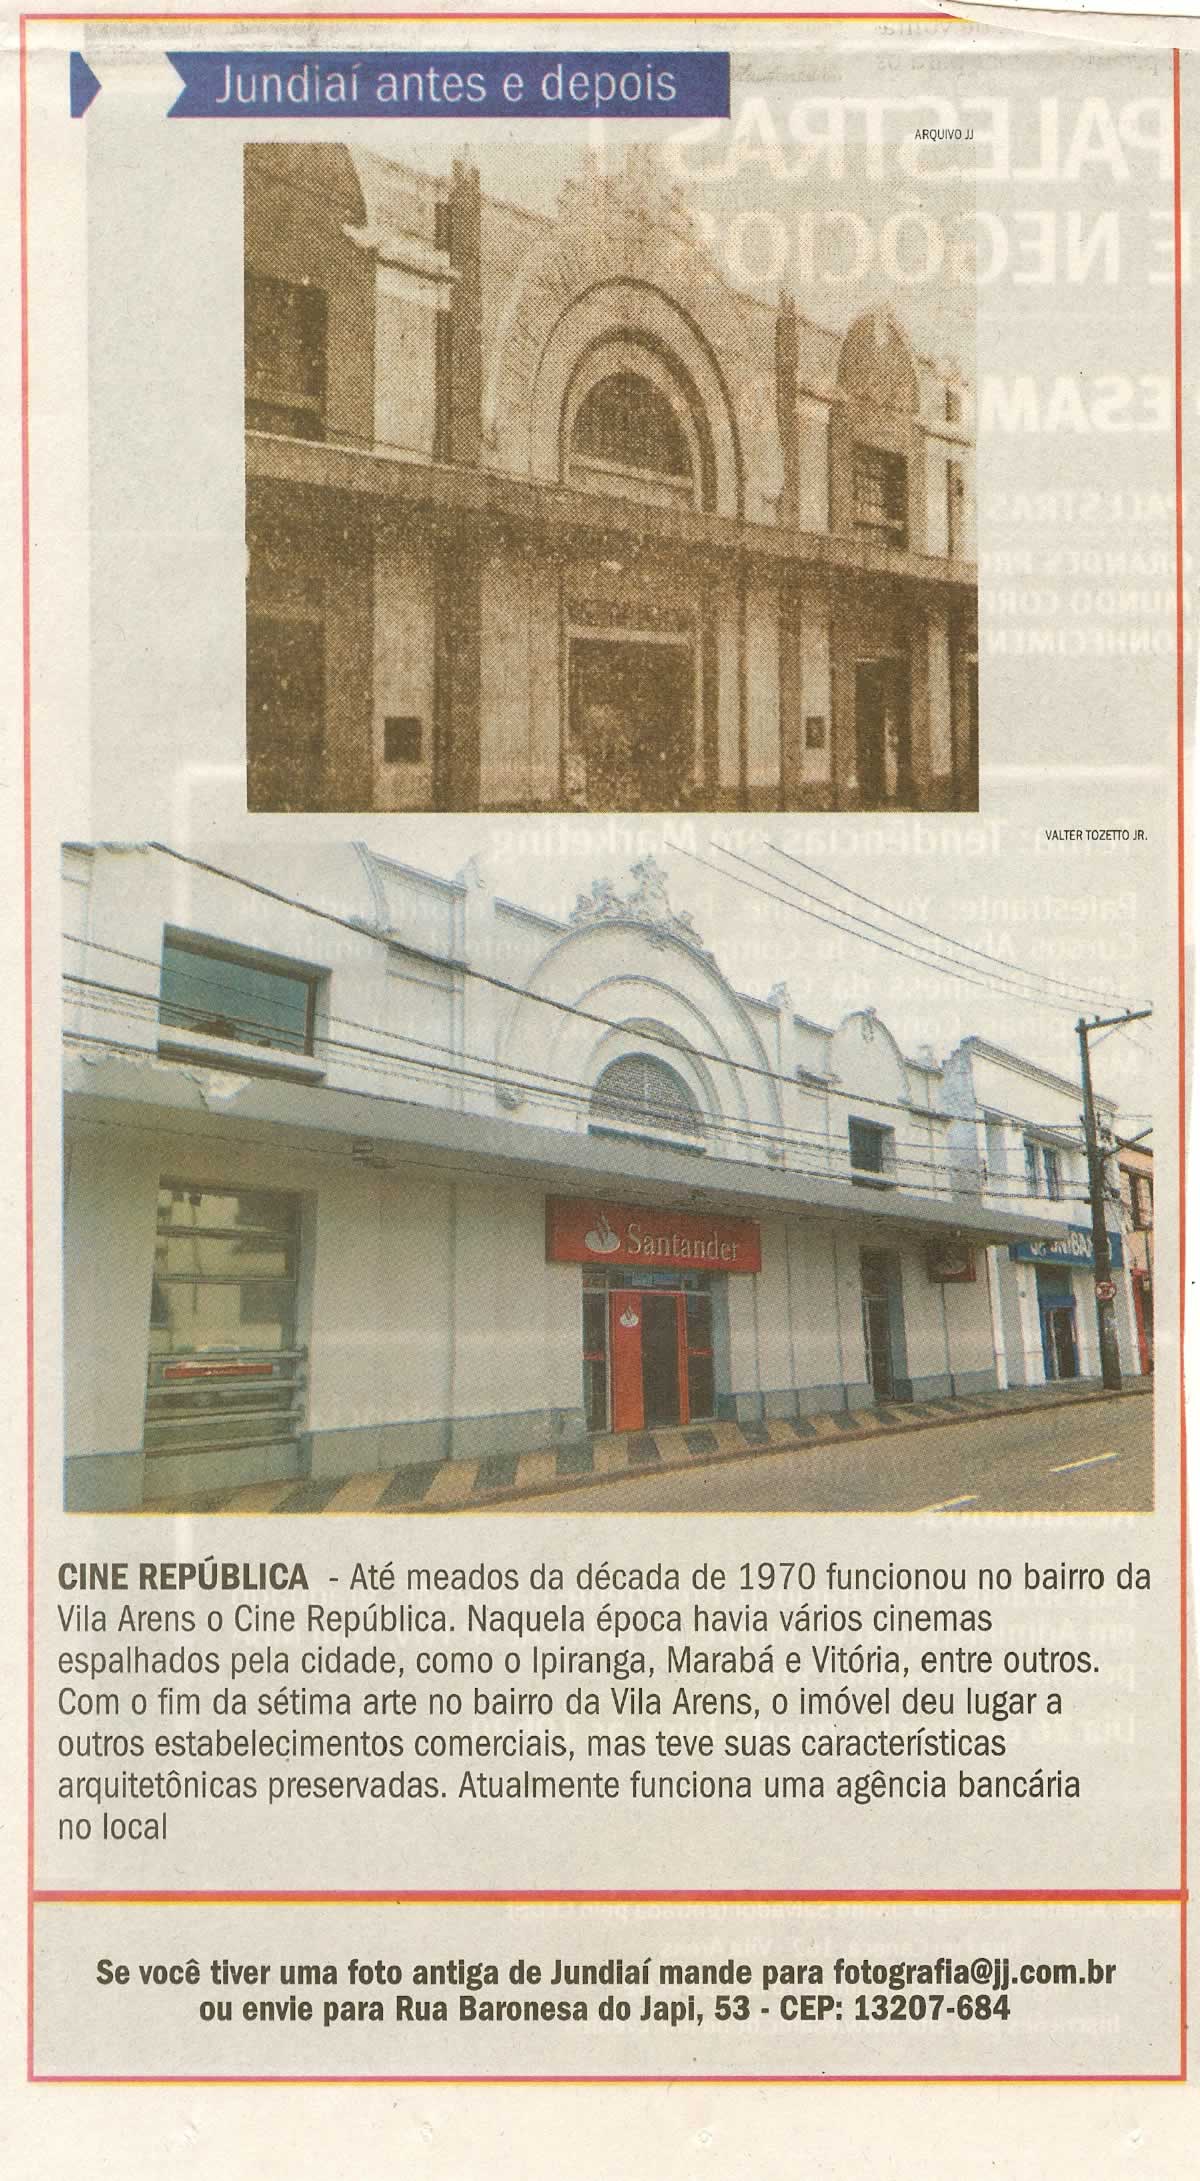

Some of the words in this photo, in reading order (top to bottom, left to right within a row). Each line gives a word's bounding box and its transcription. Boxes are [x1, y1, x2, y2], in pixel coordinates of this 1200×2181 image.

[216, 63, 360, 104] Jundiaí
[376, 71, 487, 102] antes
[502, 76, 524, 102] e
[541, 63, 677, 108] depois
[914, 128, 962, 142] ARQUIVO
[964, 128, 974, 140] JJ
[1045, 829, 1083, 841] VALTER
[1085, 829, 1130, 841] TOZETTO
[1132, 829, 1148, 841] JR.
[624, 1223, 740, 1262] Santander
[58, 1562, 129, 1591] CINE
[139, 1554, 310, 1591] REPÚBLICA
[349, 1560, 395, 1591] Até
[407, 1562, 520, 1591] meados
[529, 1562, 564, 1591] da
[576, 1560, 680, 1591] década
[691, 1562, 726, 1591] de
[739, 1562, 816, 1591] 1970
[825, 1561, 966, 1591] funcionou
[978, 1568, 1012, 1591] no
[1024, 1561, 1105, 1590] bairro
[1116, 1561, 1151, 1590] da
[57, 1604, 107, 1633] Vila
[117, 1604, 196, 1633] Arens
[207, 1610, 223, 1633] o
[234, 1603, 296, 1633] Cine
[307, 1602, 455, 1639] República.
[468, 1604, 585, 1639] Naquela
[596, 1602, 682, 1639] época
[694, 1604, 768, 1632] havia
[779, 1602, 863, 1632] vários
[873, 1603, 993, 1632] cinemas
[58, 1645, 221, 1681] espalhados
[231, 1645, 289, 1680] pela
[301, 1645, 404, 1679] cidade,
[416, 1651, 493, 1674] como
[504, 1651, 521, 1674] o
[533, 1645, 655, 1681] Ipiranga,
[667, 1644, 774, 1674] Marabá
[785, 1651, 801, 1674] e
[811, 1643, 909, 1678] Vitória,
[920, 1647, 993, 1674] entre
[1003, 1647, 1099, 1674] outros.
[58, 1687, 119, 1716] Com
[131, 1693, 147, 1716] o
[157, 1687, 200, 1716] fim
[212, 1687, 247, 1716] da
[257, 1685, 351, 1716] sétima
[363, 1689, 417, 1716] arte
[429, 1693, 463, 1716] no
[474, 1687, 554, 1716] bairro
[565, 1687, 600, 1716] da
[610, 1687, 661, 1716] Vila
[672, 1687, 760, 1720] Arens,
[772, 1693, 788, 1716] o
[800, 1685, 890, 1715] imóvel
[902, 1687, 954, 1715] deu
[967, 1687, 1038, 1722] lugar
[1046, 1692, 1062, 1715] a
[58, 1731, 145, 1757] outros
[154, 1728, 404, 1758] estabelecimentos
[414, 1728, 575, 1762] comerciais,
[587, 1735, 646, 1757] mas
[655, 1730, 714, 1757] teve
[724, 1734, 791, 1757] suas
[801, 1726, 1007, 1757] características
[58, 1769, 258, 1805] arquitetônicas
[268, 1770, 447, 1805] preservadas.
[458, 1770, 620, 1799] Atualmente
[629, 1769, 752, 1799] funciona
[764, 1776, 825, 1799] uma
[836, 1769, 946, 1806] agência
[959, 1767, 1080, 1799] bancária
[59, 1818, 92, 1841] no
[103, 1811, 167, 1841] local
[96, 1958, 130, 1986] Se
[138, 1957, 201, 1985] você
[210, 1958, 271, 1986] tiver
[280, 1964, 338, 1985] uma
[347, 1958, 403, 1986] foto
[412, 1958, 499, 1992] antiga
[508, 1959, 542, 1985] de
[550, 1956, 653, 1986] Jundiaí
[659, 1958, 753, 1985] mande
[762, 1964, 824, 1991] para
[833, 1957, 1117, 1992] fotografia@jj.com.br
[199, 2000, 233, 2022] ou
[242, 1994, 313, 2022] envie
[323, 2000, 384, 2028] para
[396, 1995, 448, 2022] Rua
[459, 1995, 588, 2022] Baronesa
[598, 1994, 631, 2022] do
[639, 1994, 704, 2028] Japi,
[714, 1994, 751, 2022] 53
[779, 1994, 843, 2021] CEP:
[855, 1993, 1011, 2021] 13207-684
